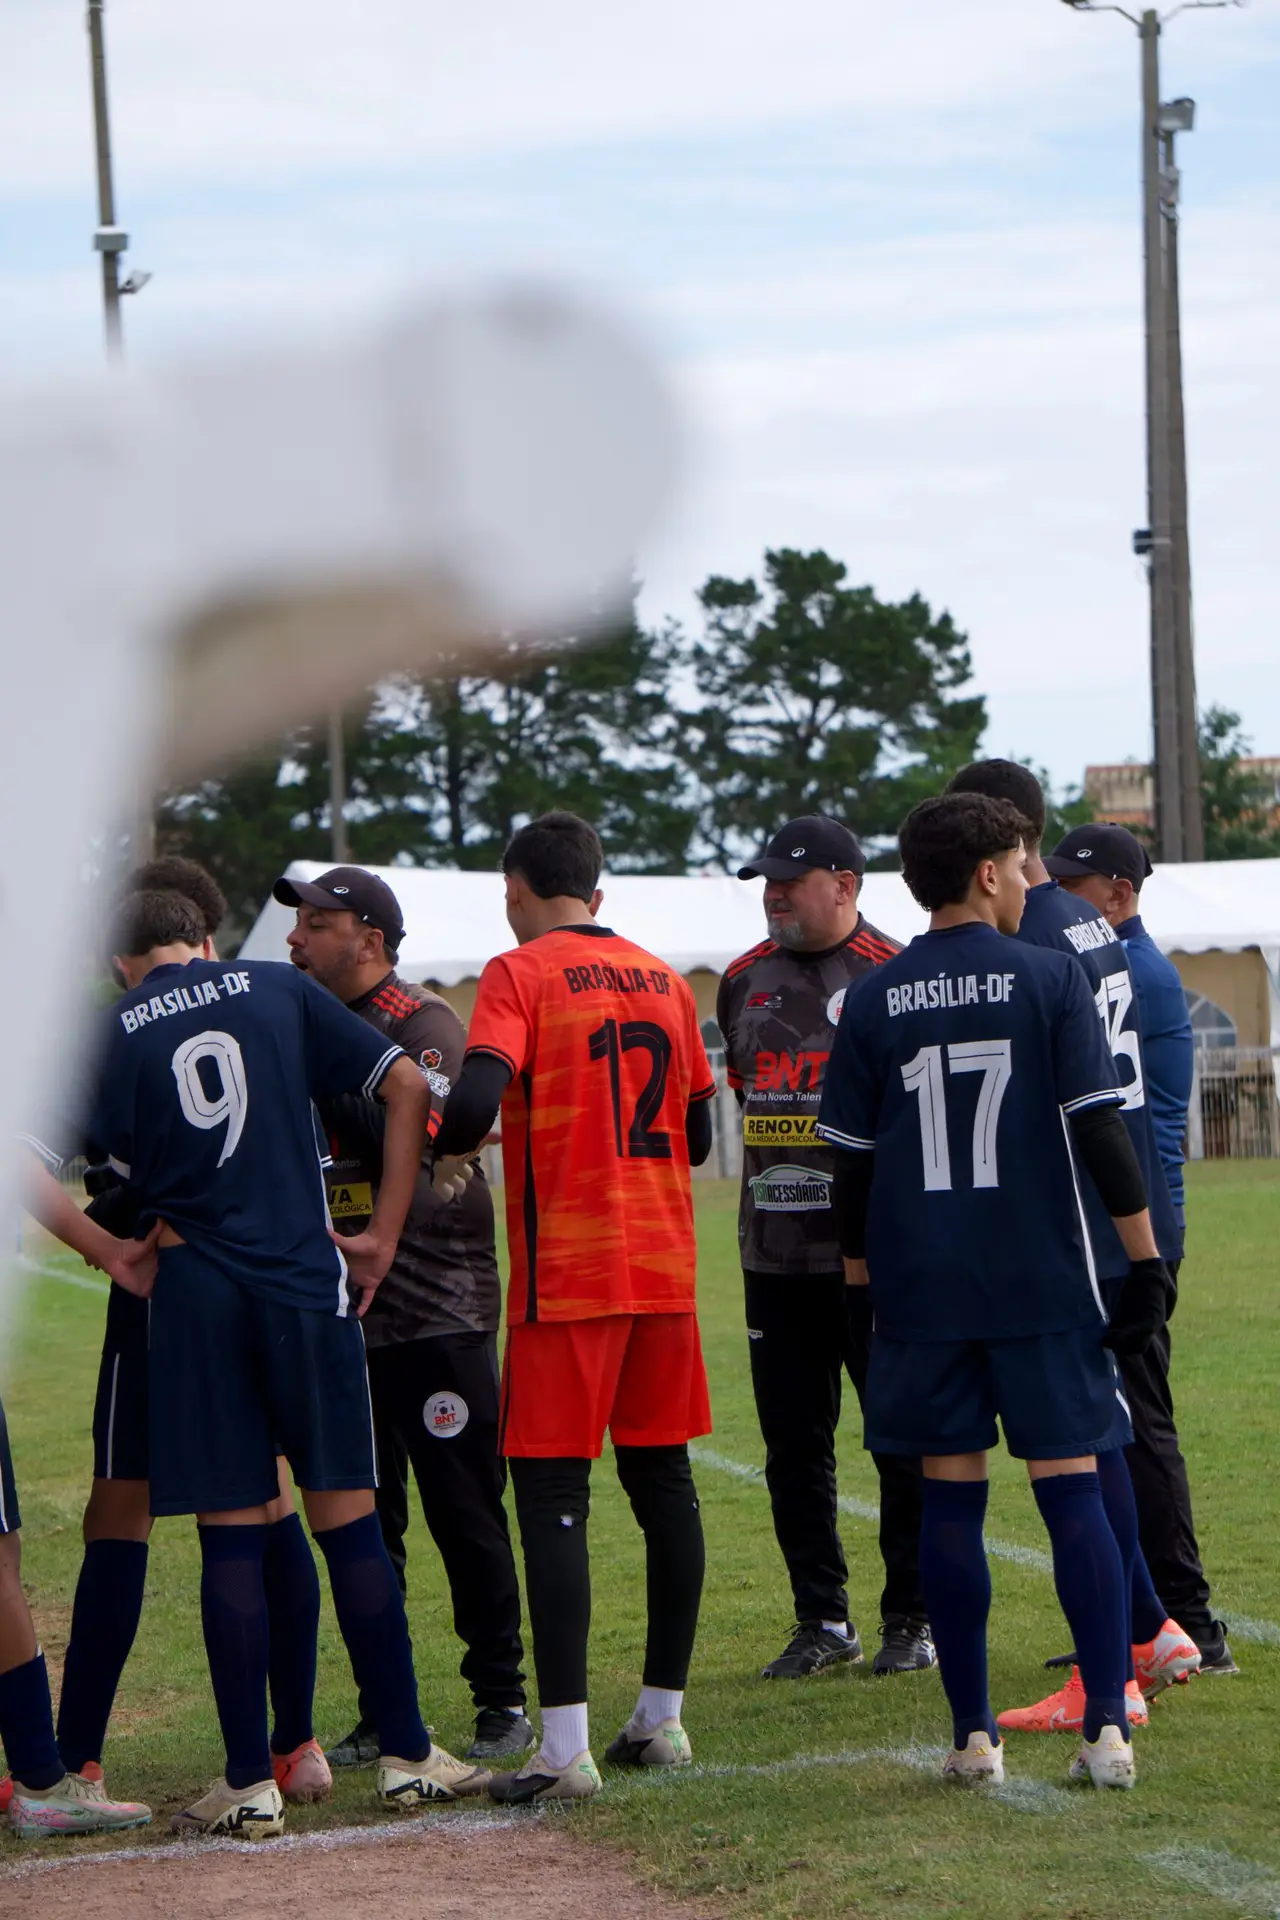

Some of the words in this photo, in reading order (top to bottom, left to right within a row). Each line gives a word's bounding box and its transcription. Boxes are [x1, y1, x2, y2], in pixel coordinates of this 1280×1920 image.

[120, 971, 251, 1035] BRASÍLIA-DF
[563, 961, 671, 997] BRASÍLIA-DF
[886, 972, 1016, 1017] BRASÍLIA-DF
[1094, 969, 1146, 1111] 13
[588, 1018, 673, 1159] 12
[754, 1051, 831, 1091] BNT
[768, 1092, 793, 1101] Novos
[796, 1092, 822, 1101] Talen
[171, 1030, 249, 1169] 9
[900, 1039, 1012, 1192] 17
[434, 1412, 456, 1425] BNT
